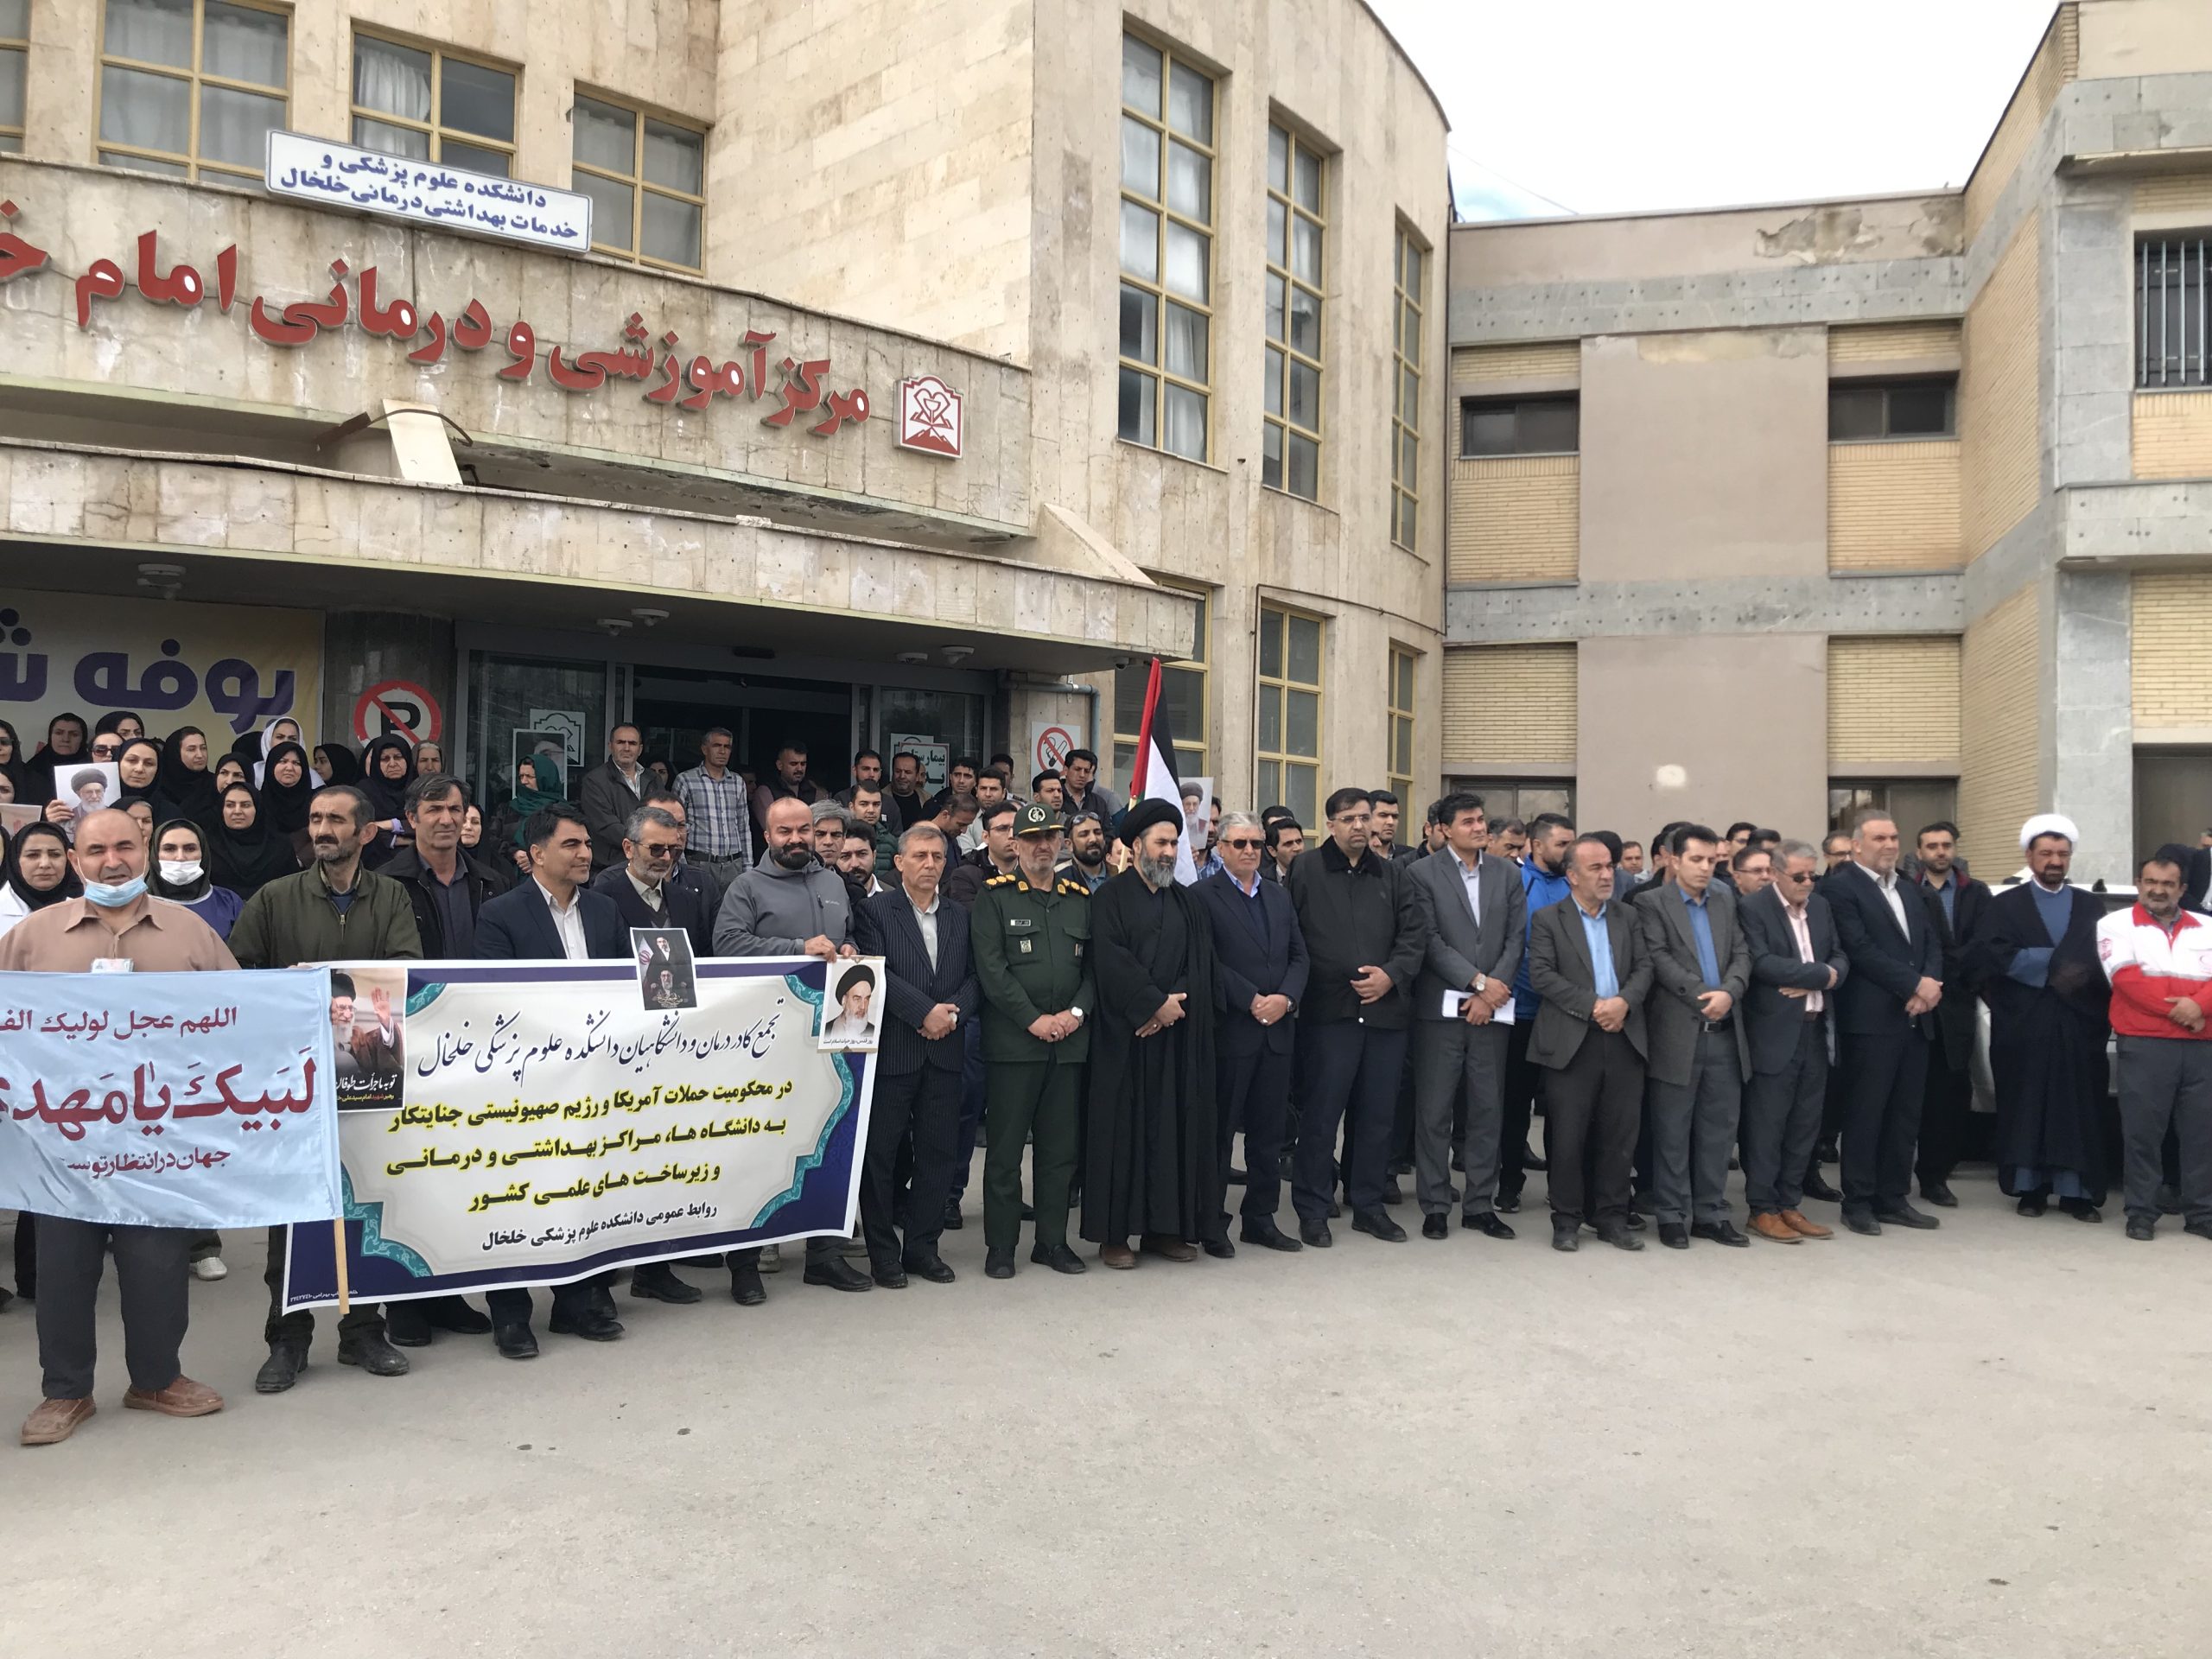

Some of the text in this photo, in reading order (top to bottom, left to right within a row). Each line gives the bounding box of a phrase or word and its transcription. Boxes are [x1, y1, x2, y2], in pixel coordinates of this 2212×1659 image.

[321, 154, 546, 208] دانشکده علوم پزشکی و
[281, 168, 578, 239] خدمات بهداشتی درمانی خلخال
[76, 229, 238, 332] امام
[250, 257, 493, 365] درمانی
[498, 320, 536, 379] و
[548, 311, 777, 410] آموزشی
[762, 358, 870, 435] مرکز
[74, 639, 295, 734] بوفه
[0, 1008, 33, 1032] الف
[113, 1010, 174, 1039] عجل
[180, 1006, 237, 1038] اللهم
[564, 1009, 619, 1061] دانشکده
[730, 1019, 764, 1051] کادر
[751, 998, 785, 1058] تجمع
[417, 1020, 474, 1077] خلخال
[474, 1010, 522, 1082] پزشکی
[520, 1033, 563, 1088] علوم
[696, 1030, 731, 1059] درمان
[388, 1079, 793, 1133] در محکومیت حملات آمریکا و رژیم صهیونیستی جنایتکار
[598, 1129, 661, 1156] مراکز
[700, 1117, 760, 1138] دانشگاه
[763, 1118, 786, 1135] به
[62, 1147, 232, 1179] جهان در انتظار توس
[386, 1147, 482, 1175] درمانی
[486, 1150, 498, 1167] و
[502, 1138, 596, 1166] بهداشتی
[592, 1173, 629, 1198] های
[711, 1165, 721, 1180] و
[467, 1182, 531, 1212] کشور
[534, 1178, 591, 1205] علمی
[481, 1201, 717, 1251] روابط عمومی دانشکده علوم پزشکی خلخال
